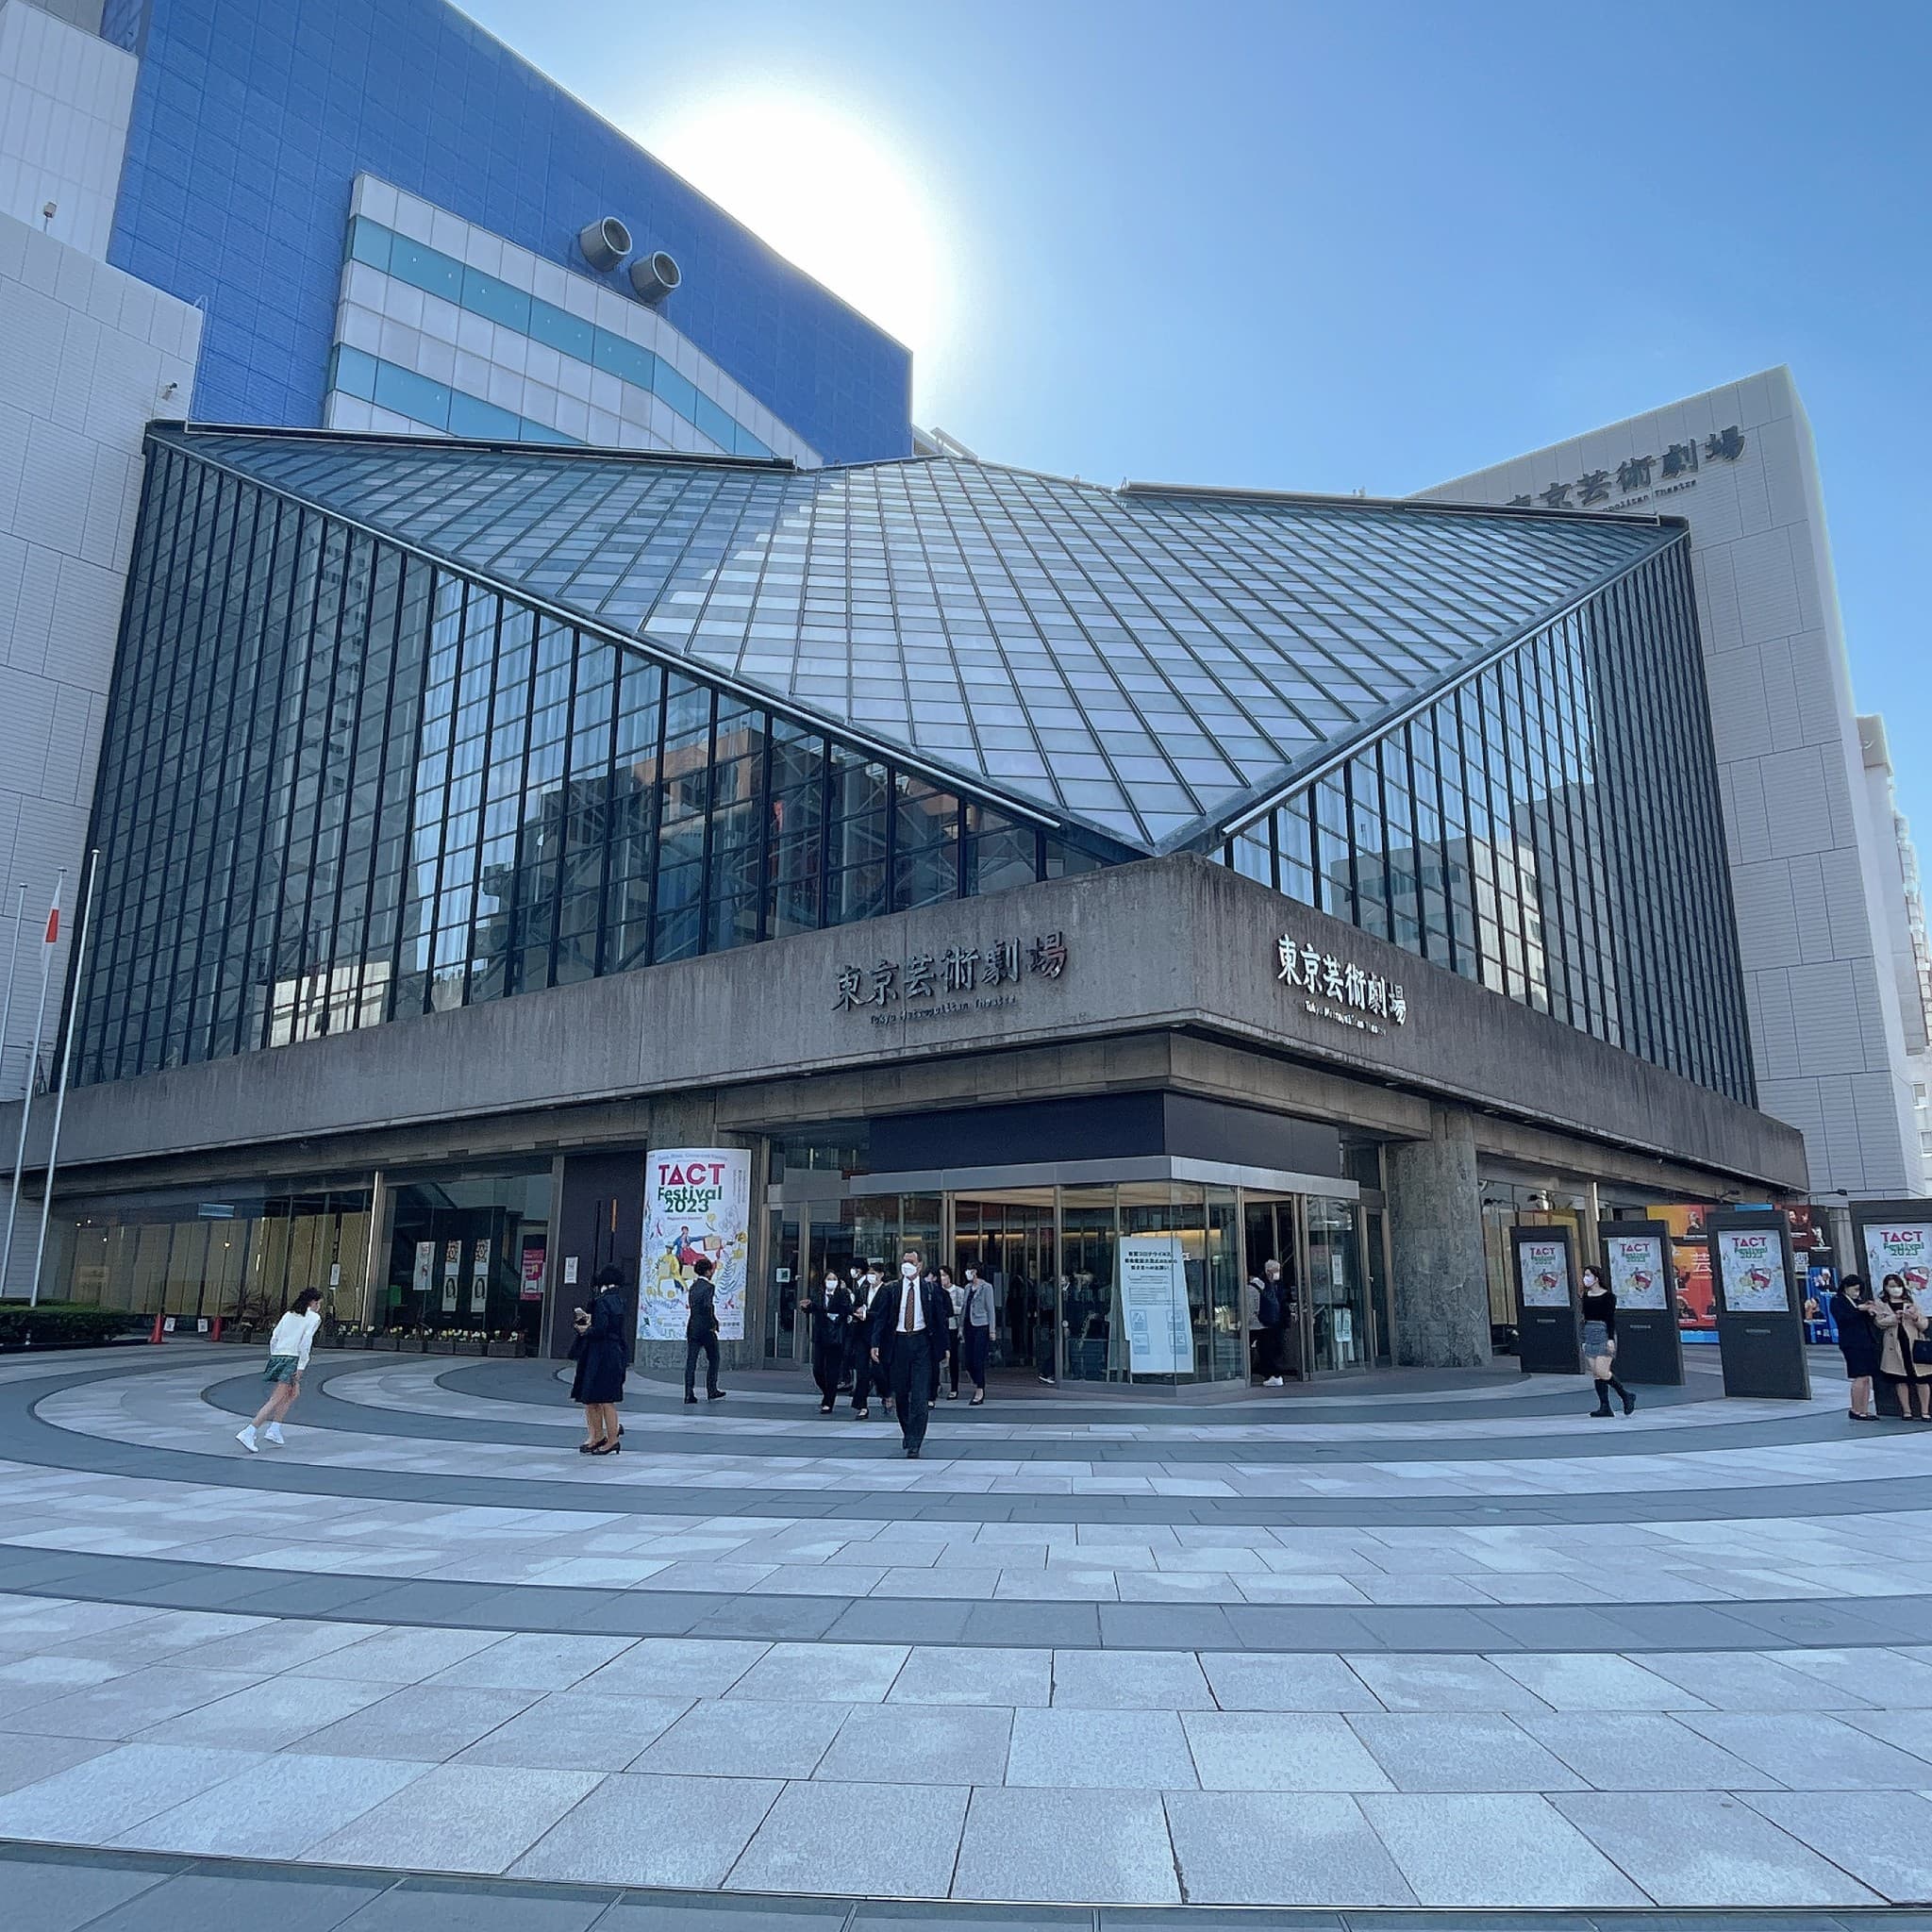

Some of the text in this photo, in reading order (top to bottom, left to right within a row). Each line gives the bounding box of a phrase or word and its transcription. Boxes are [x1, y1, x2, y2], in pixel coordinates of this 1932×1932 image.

[1507, 425, 1745, 508] 京芸術劇場
[831, 930, 1069, 1011] 東京芸術劇場
[1277, 933, 1407, 1025] 東京芸術劇場
[658, 1162, 725, 1185] TACT
[658, 1185, 723, 1201] Festival
[664, 1198, 709, 1212] 2023
[1731, 1237, 1767, 1247] TACT
[1880, 1230, 1924, 1242] TACT
[1530, 1247, 1556, 1256] TACT
[1620, 1243, 1650, 1252] TACT
